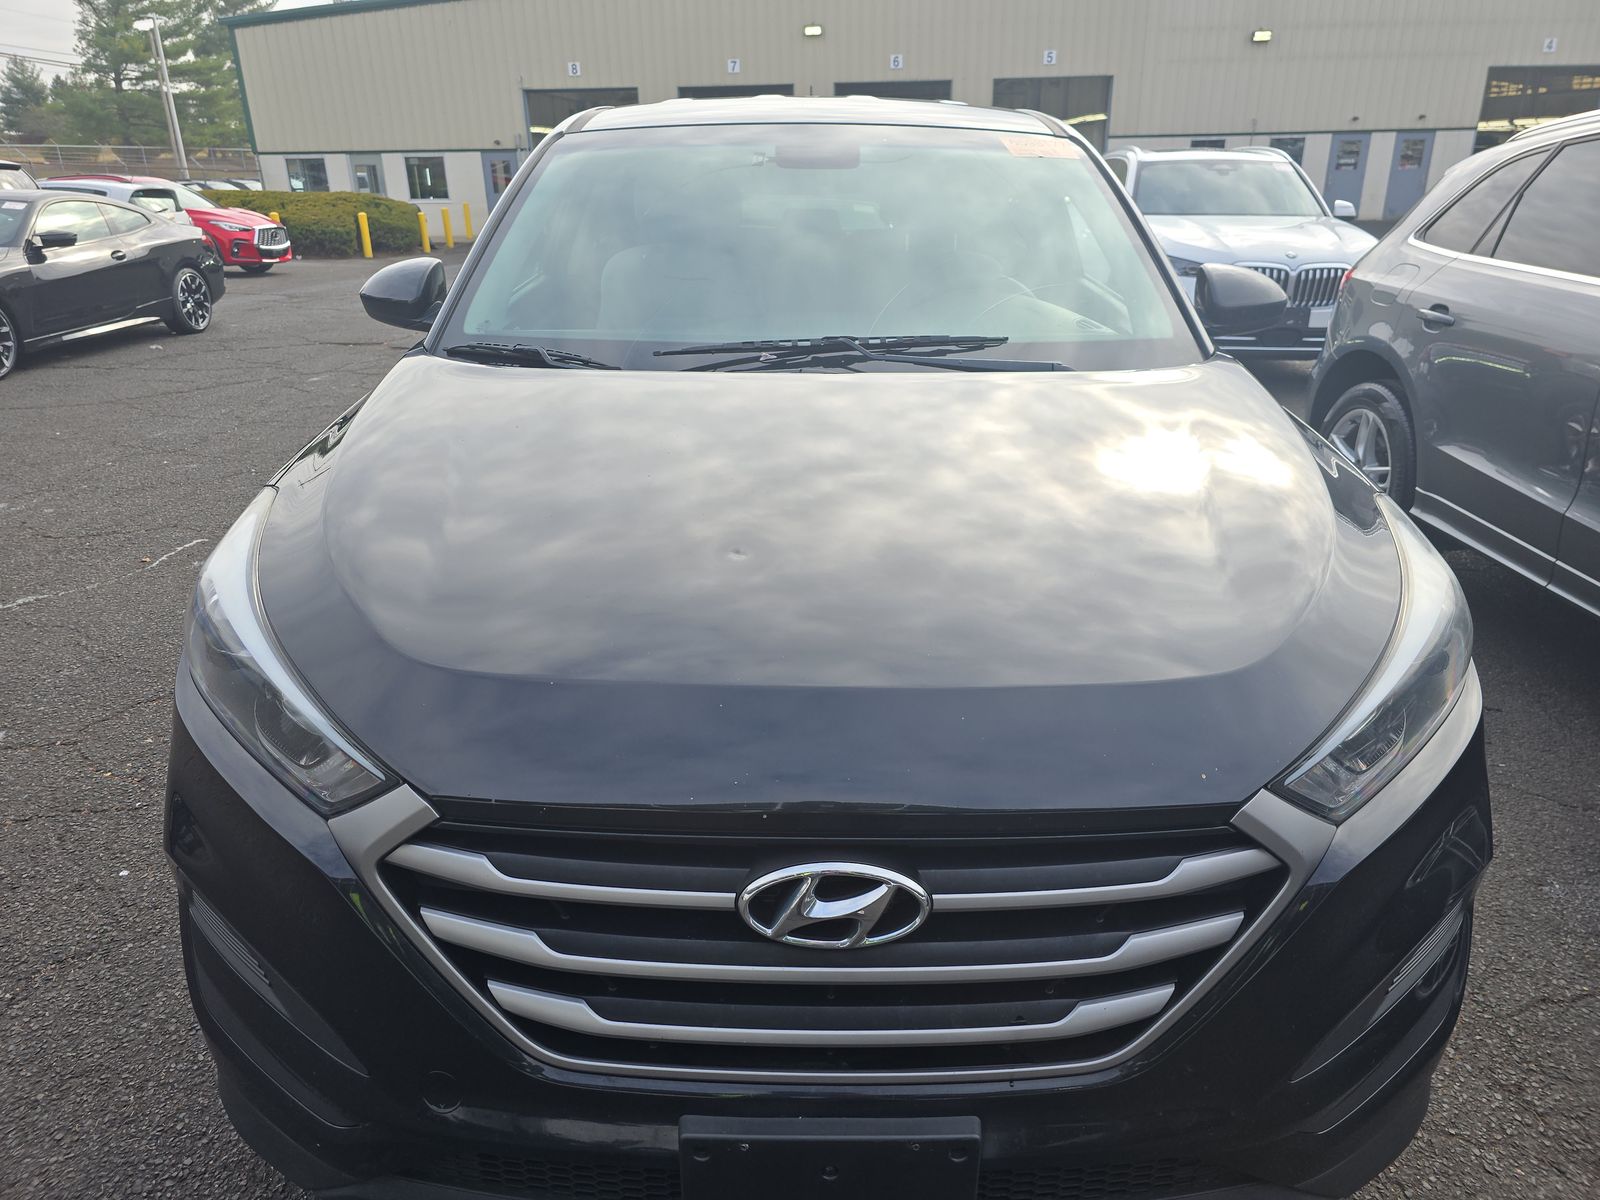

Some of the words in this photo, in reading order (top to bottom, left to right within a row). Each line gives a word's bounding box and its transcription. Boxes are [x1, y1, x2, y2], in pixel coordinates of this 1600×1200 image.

[1545, 39, 1554, 50] 4
[892, 56, 900, 67] 6
[1046, 51, 1053, 63] 5
[571, 63, 578, 75] 8
[730, 60, 737, 72] 7
